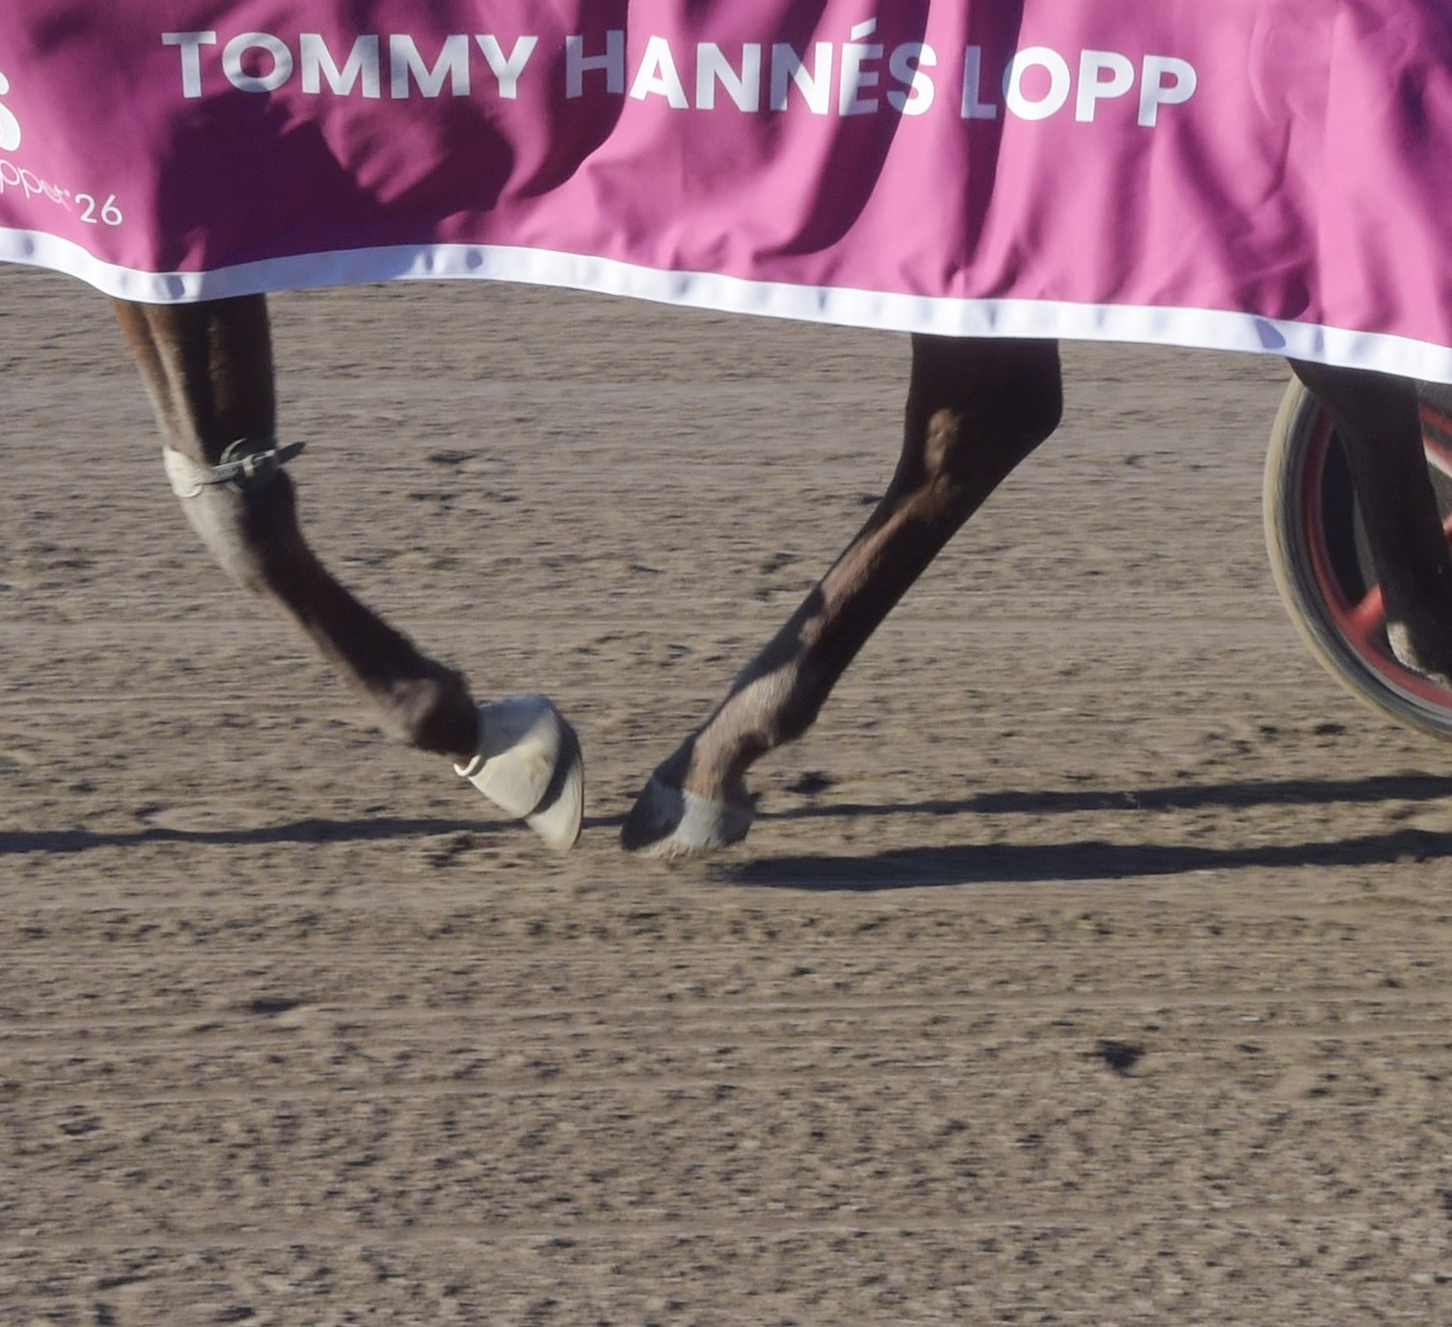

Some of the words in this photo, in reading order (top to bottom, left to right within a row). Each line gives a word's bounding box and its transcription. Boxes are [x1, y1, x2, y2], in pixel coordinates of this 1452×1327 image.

[162, 30, 539, 101] TOMMY
[566, 17, 936, 117] HANNÉS
[960, 44, 1198, 127] LOPP
[74, 193, 123, 226] 26
